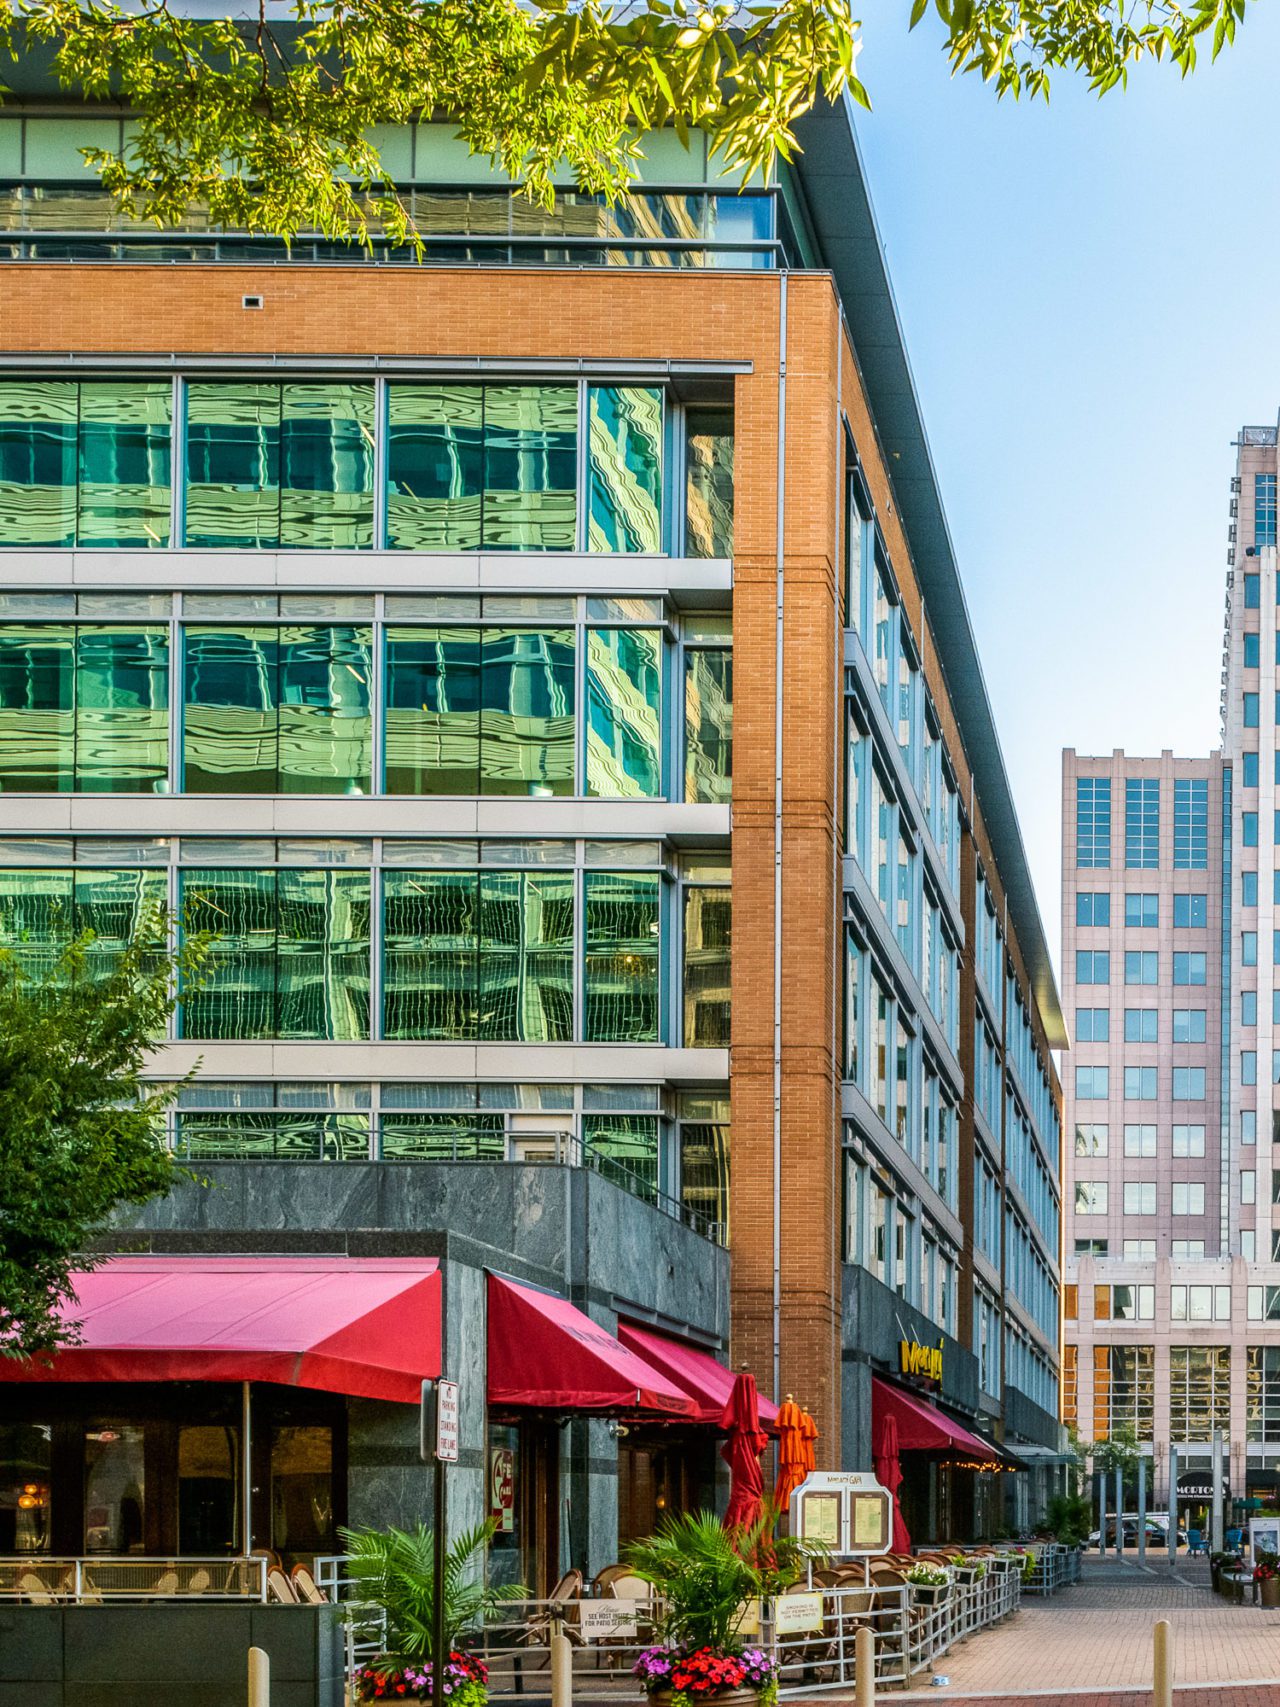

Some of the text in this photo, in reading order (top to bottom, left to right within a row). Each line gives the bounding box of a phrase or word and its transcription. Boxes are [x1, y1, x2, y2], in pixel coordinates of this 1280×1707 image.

[442, 1400, 456, 1412] PARKING
[441, 1421, 457, 1433] STANDING
[1176, 1486, 1227, 1494] MORTONS
